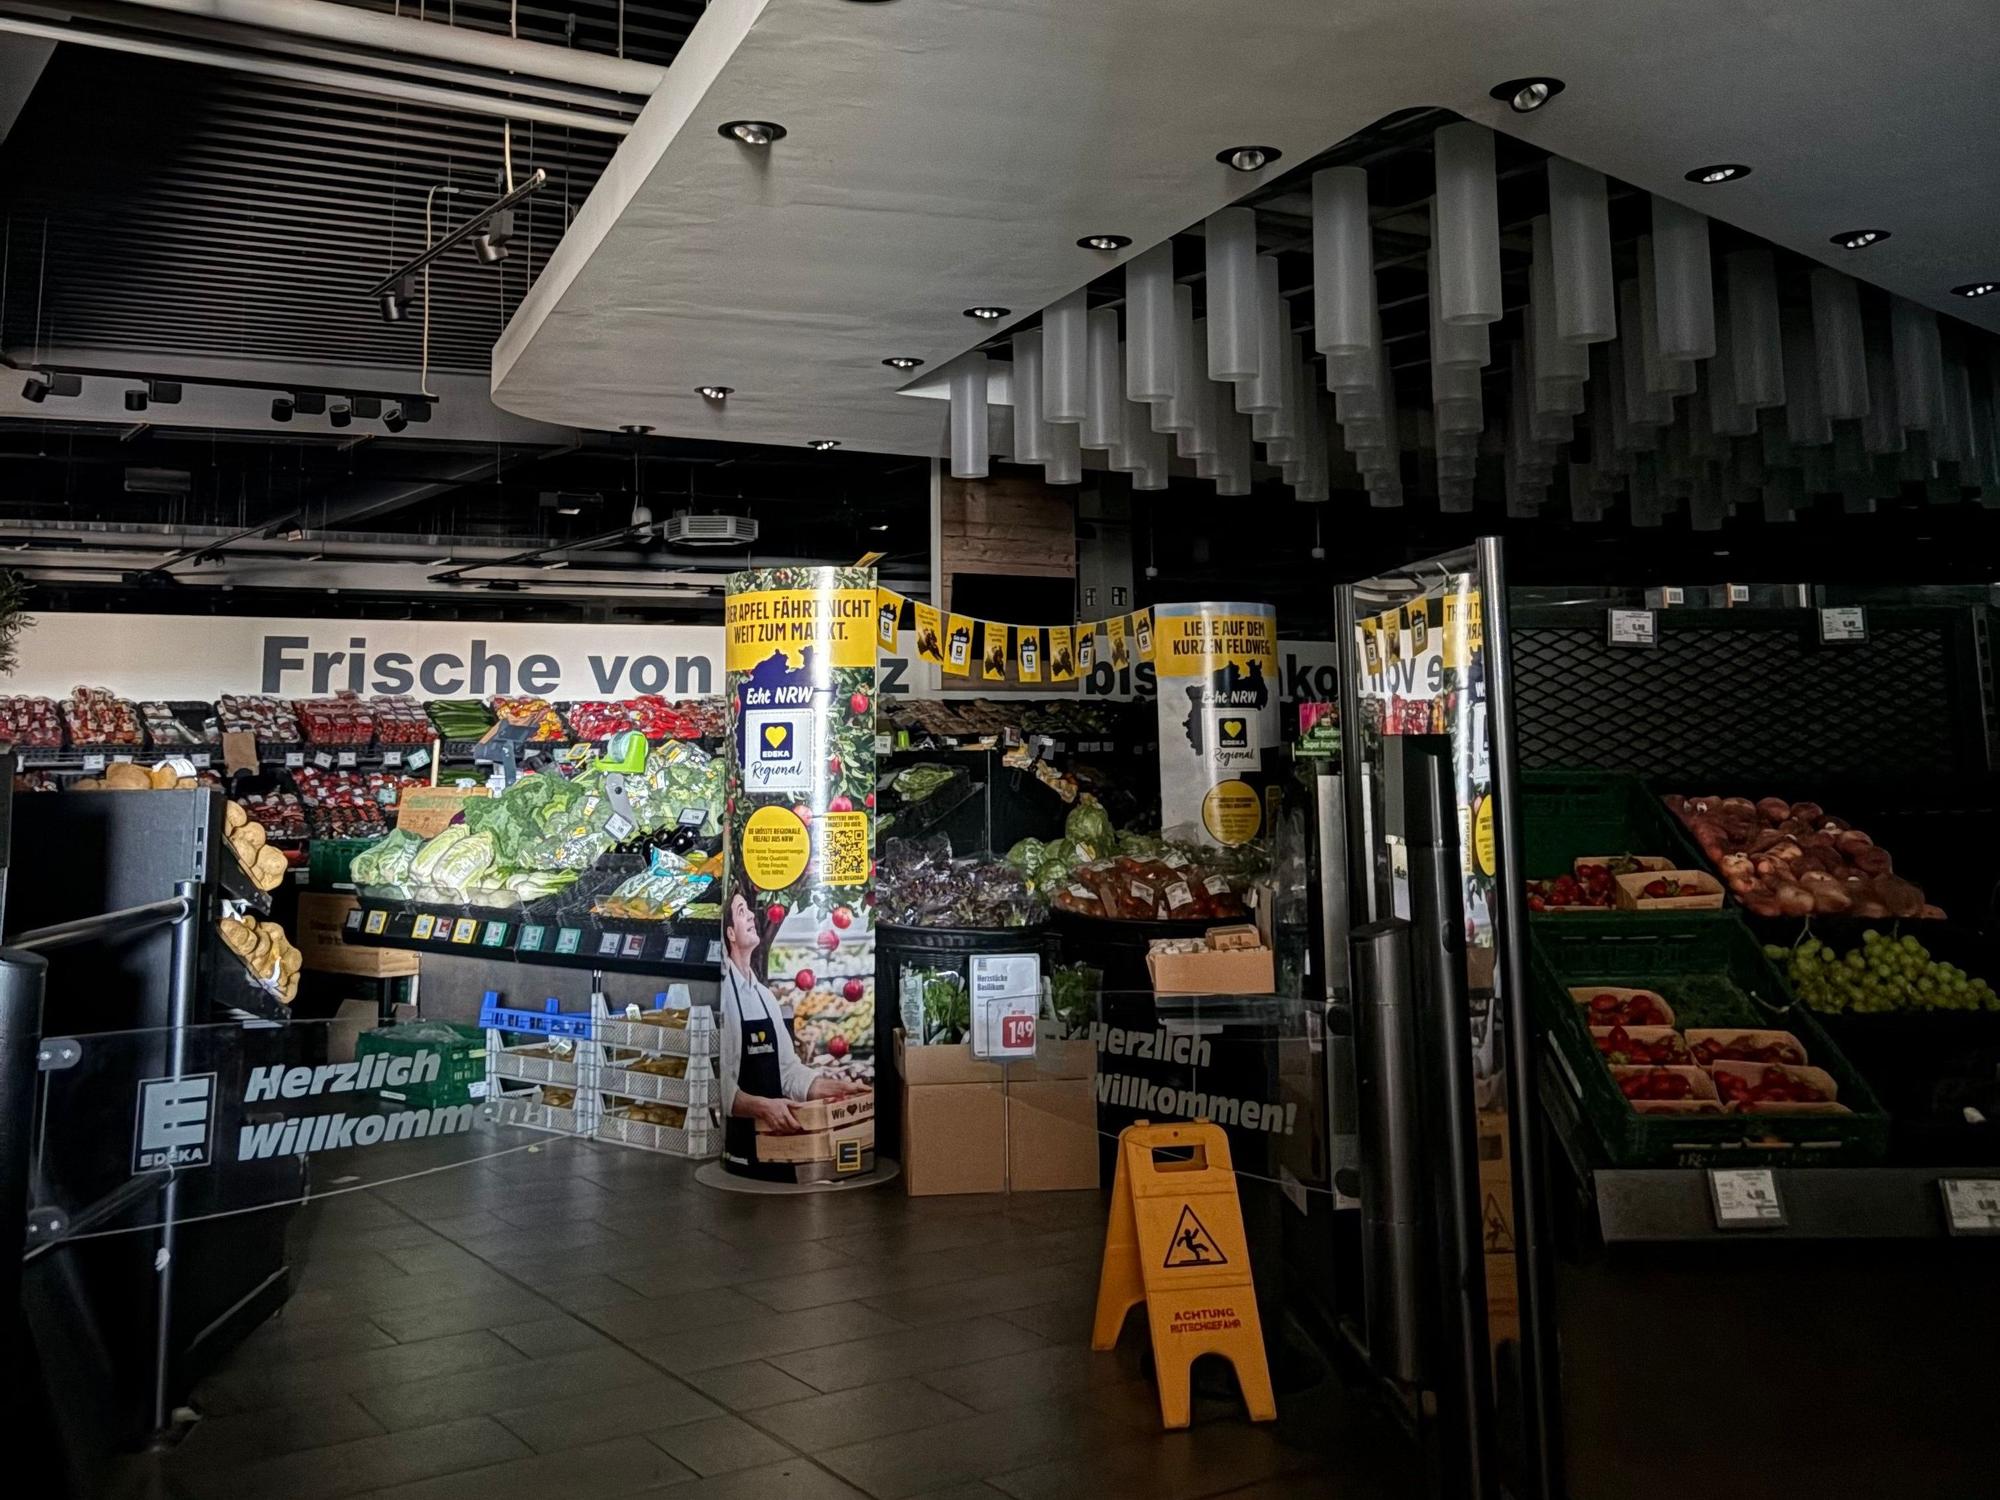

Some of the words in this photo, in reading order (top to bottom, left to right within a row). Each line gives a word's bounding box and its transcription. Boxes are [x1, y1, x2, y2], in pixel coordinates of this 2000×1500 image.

[739, 600, 769, 622] APFEL
[774, 596, 819, 618] FÄHRT
[828, 600, 871, 618] NICHT
[734, 625, 755, 644] WEIT
[758, 622, 786, 641] ZUM
[1222, 620, 1245, 636] AUF
[1248, 620, 1265, 636] DEM
[262, 636, 561, 694] Frische
[588, 655, 712, 695] von
[746, 687, 771, 705] Echt
[774, 686, 814, 704] NRW
[1231, 690, 1258, 704] NRW
[762, 750, 790, 758] EDEKA
[1214, 748, 1254, 766] Regional
[752, 760, 803, 784] Regional
[1088, 1021, 1212, 1068] Herzlich
[244, 1048, 441, 1103] Herzlich
[237, 1089, 547, 1162] Willkommen!
[1174, 1308, 1235, 1322] ACHTUNG
[1170, 1318, 1242, 1334] RUTSCHGEFAHR
